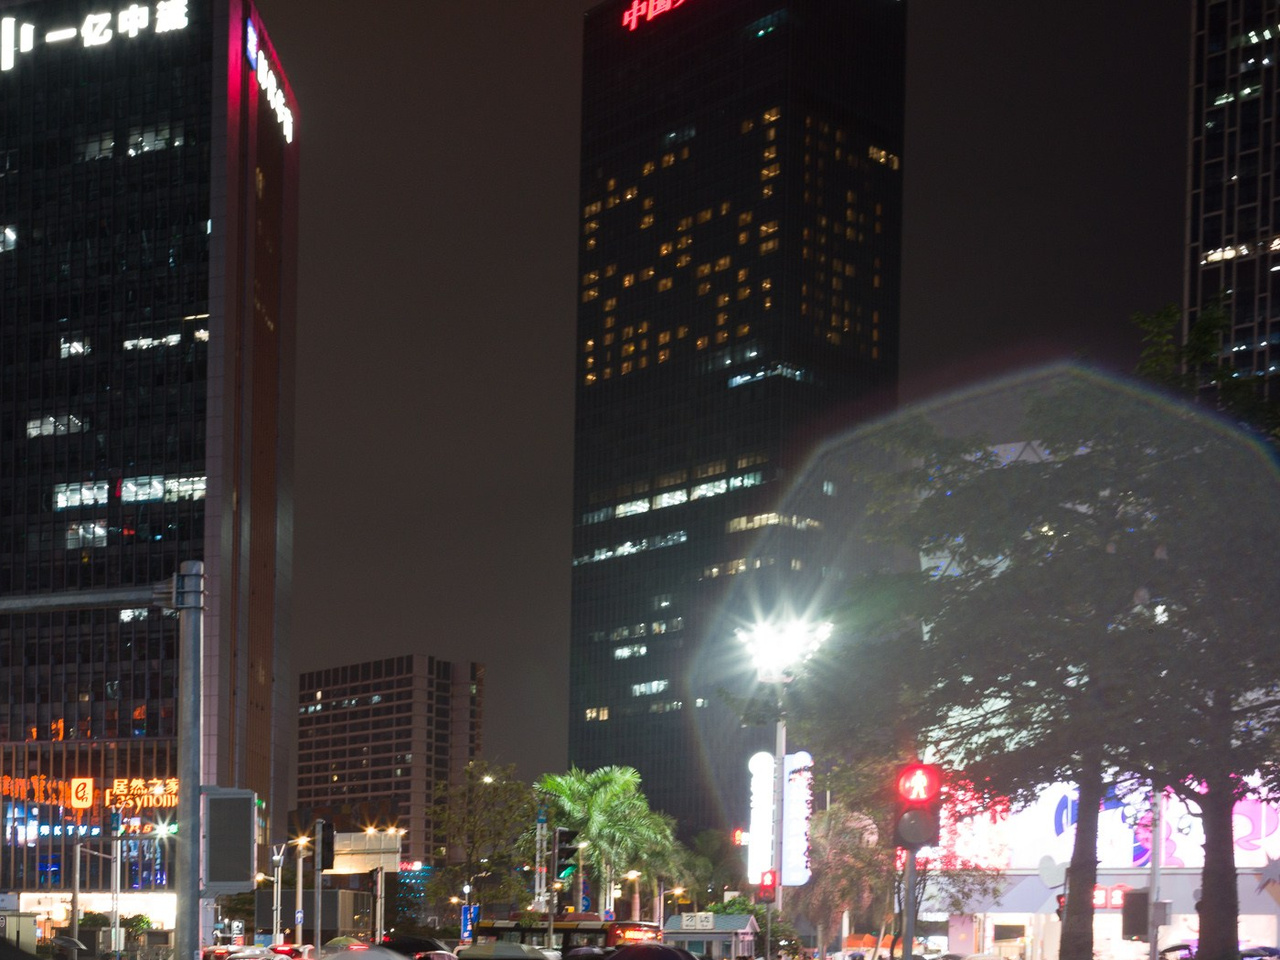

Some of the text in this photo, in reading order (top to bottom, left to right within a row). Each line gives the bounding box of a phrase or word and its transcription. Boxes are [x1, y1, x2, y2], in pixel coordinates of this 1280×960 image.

[622, 0, 688, 31] 中国
[112, 778, 179, 795] 居然之家
